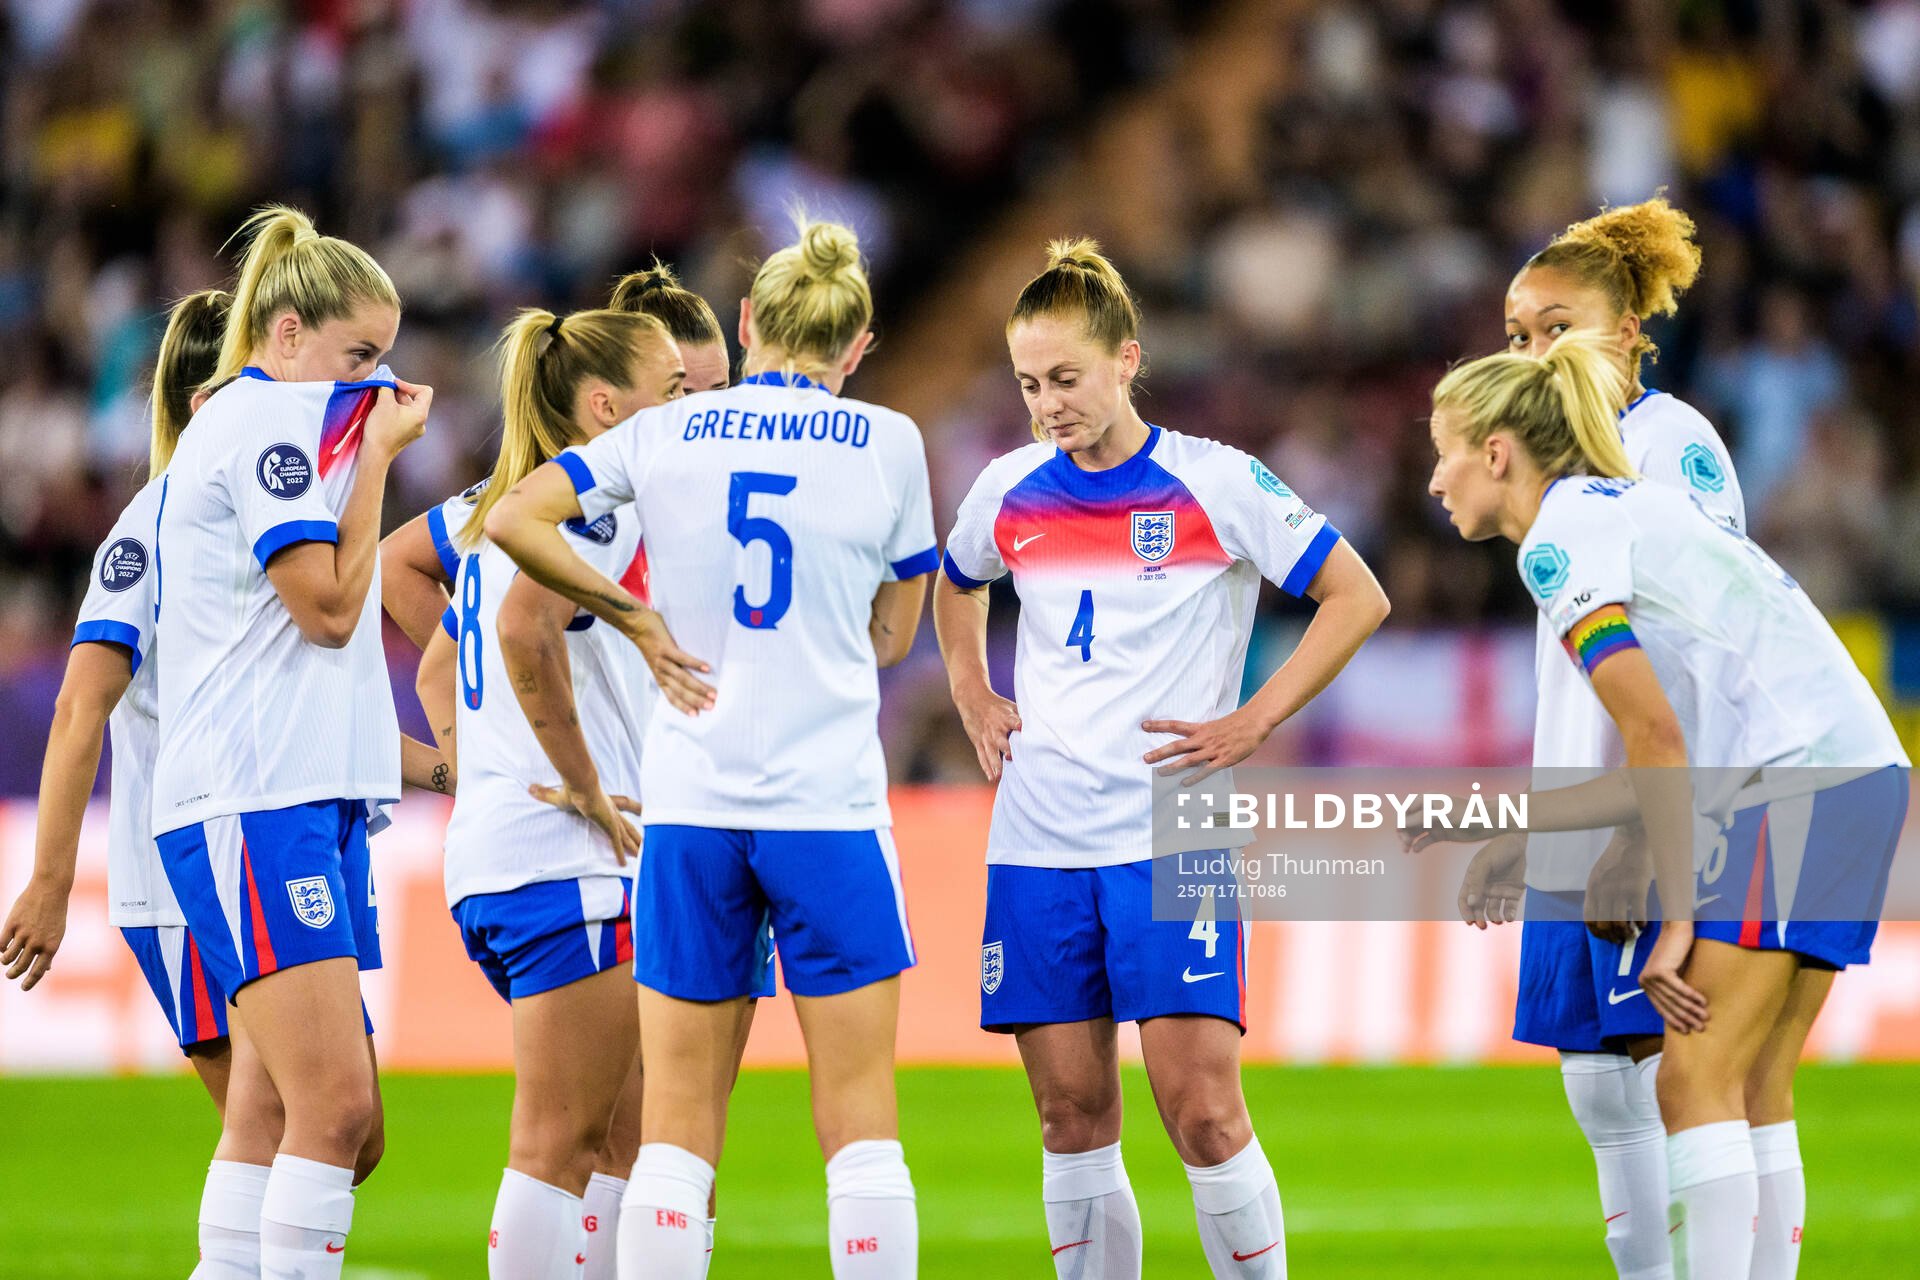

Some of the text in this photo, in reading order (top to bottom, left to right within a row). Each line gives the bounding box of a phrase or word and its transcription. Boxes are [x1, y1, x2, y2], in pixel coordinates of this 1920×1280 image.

[683, 409, 870, 448] GREENWOOD
[115, 564, 142, 572] CHAMPIONS
[727, 471, 798, 630] 5
[459, 553, 484, 711] 8
[1065, 589, 1096, 663] 4
[1188, 884, 1220, 959] 4
[655, 1209, 688, 1230] ENG
[846, 1236, 878, 1256] ENG
